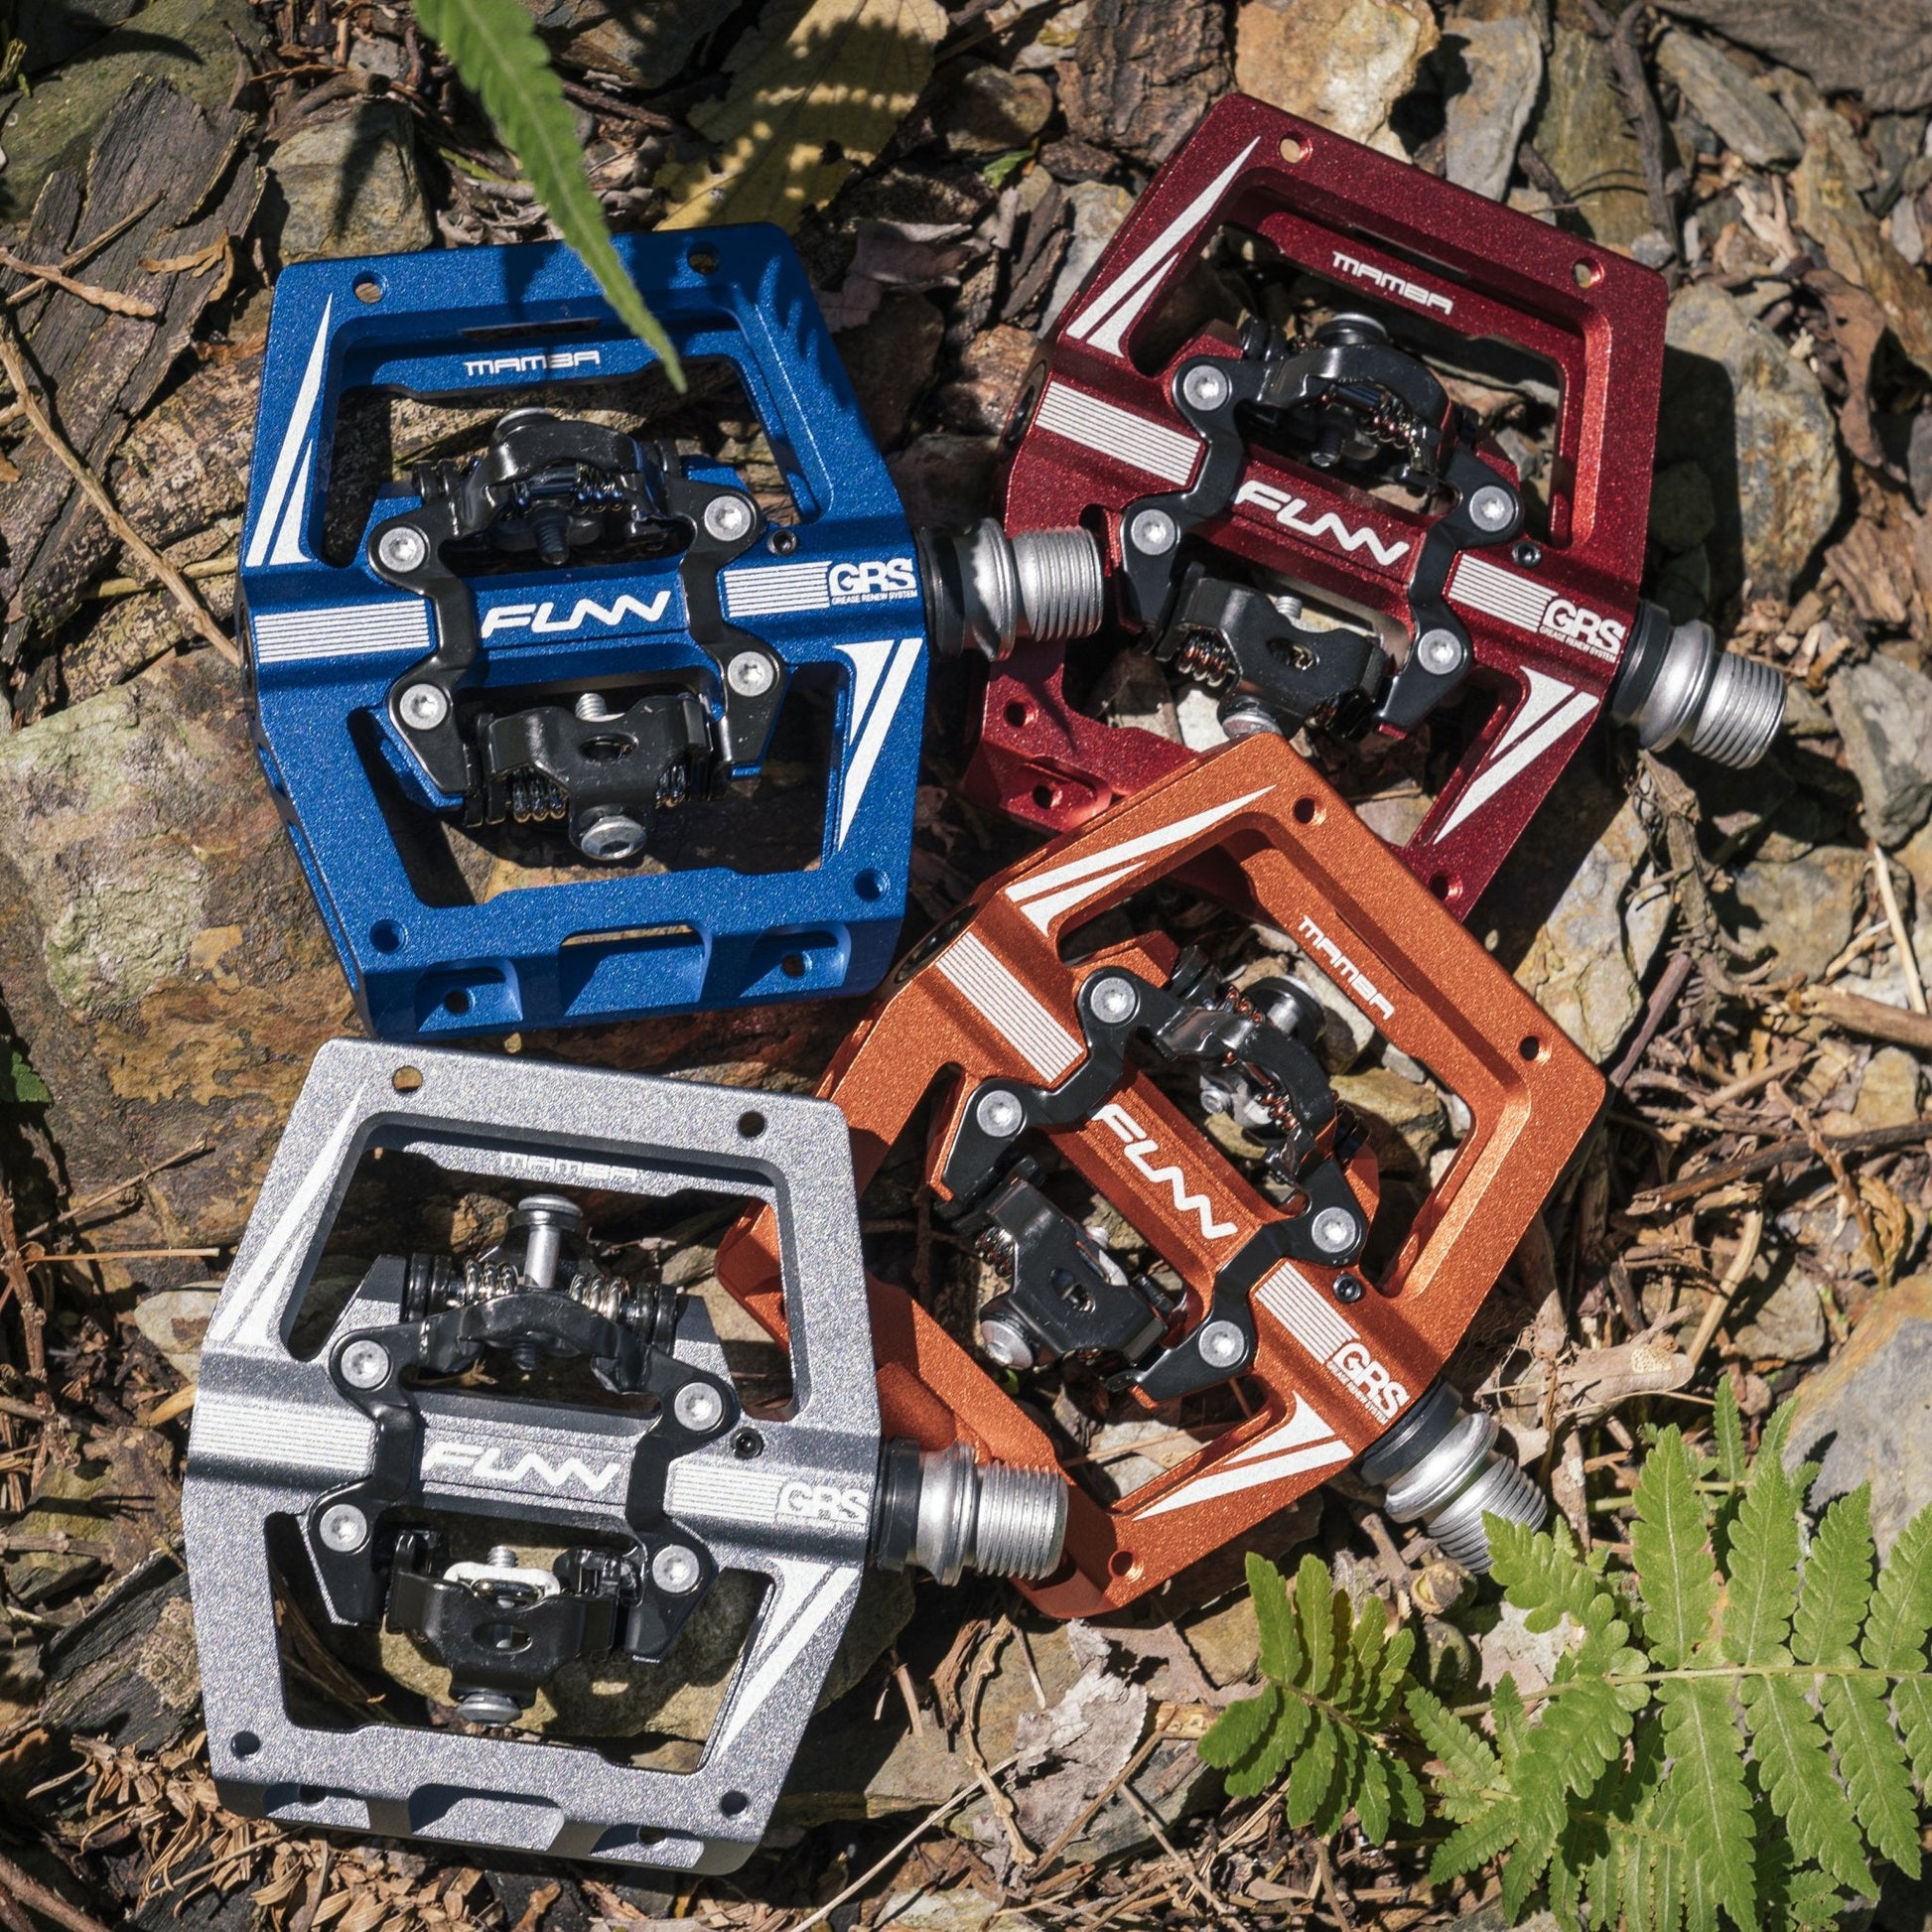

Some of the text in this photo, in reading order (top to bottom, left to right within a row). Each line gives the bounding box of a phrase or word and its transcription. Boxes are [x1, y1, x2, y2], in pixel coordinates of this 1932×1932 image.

[1332, 250, 1453, 316] MAMBA
[464, 349, 601, 377] MAMBA
[829, 557, 917, 596] GRS
[1542, 598, 1626, 655] GRS
[1297, 914, 1395, 1021] MAMBA
[1331, 1341, 1411, 1420] GRS
[777, 1480, 870, 1523] GRS
